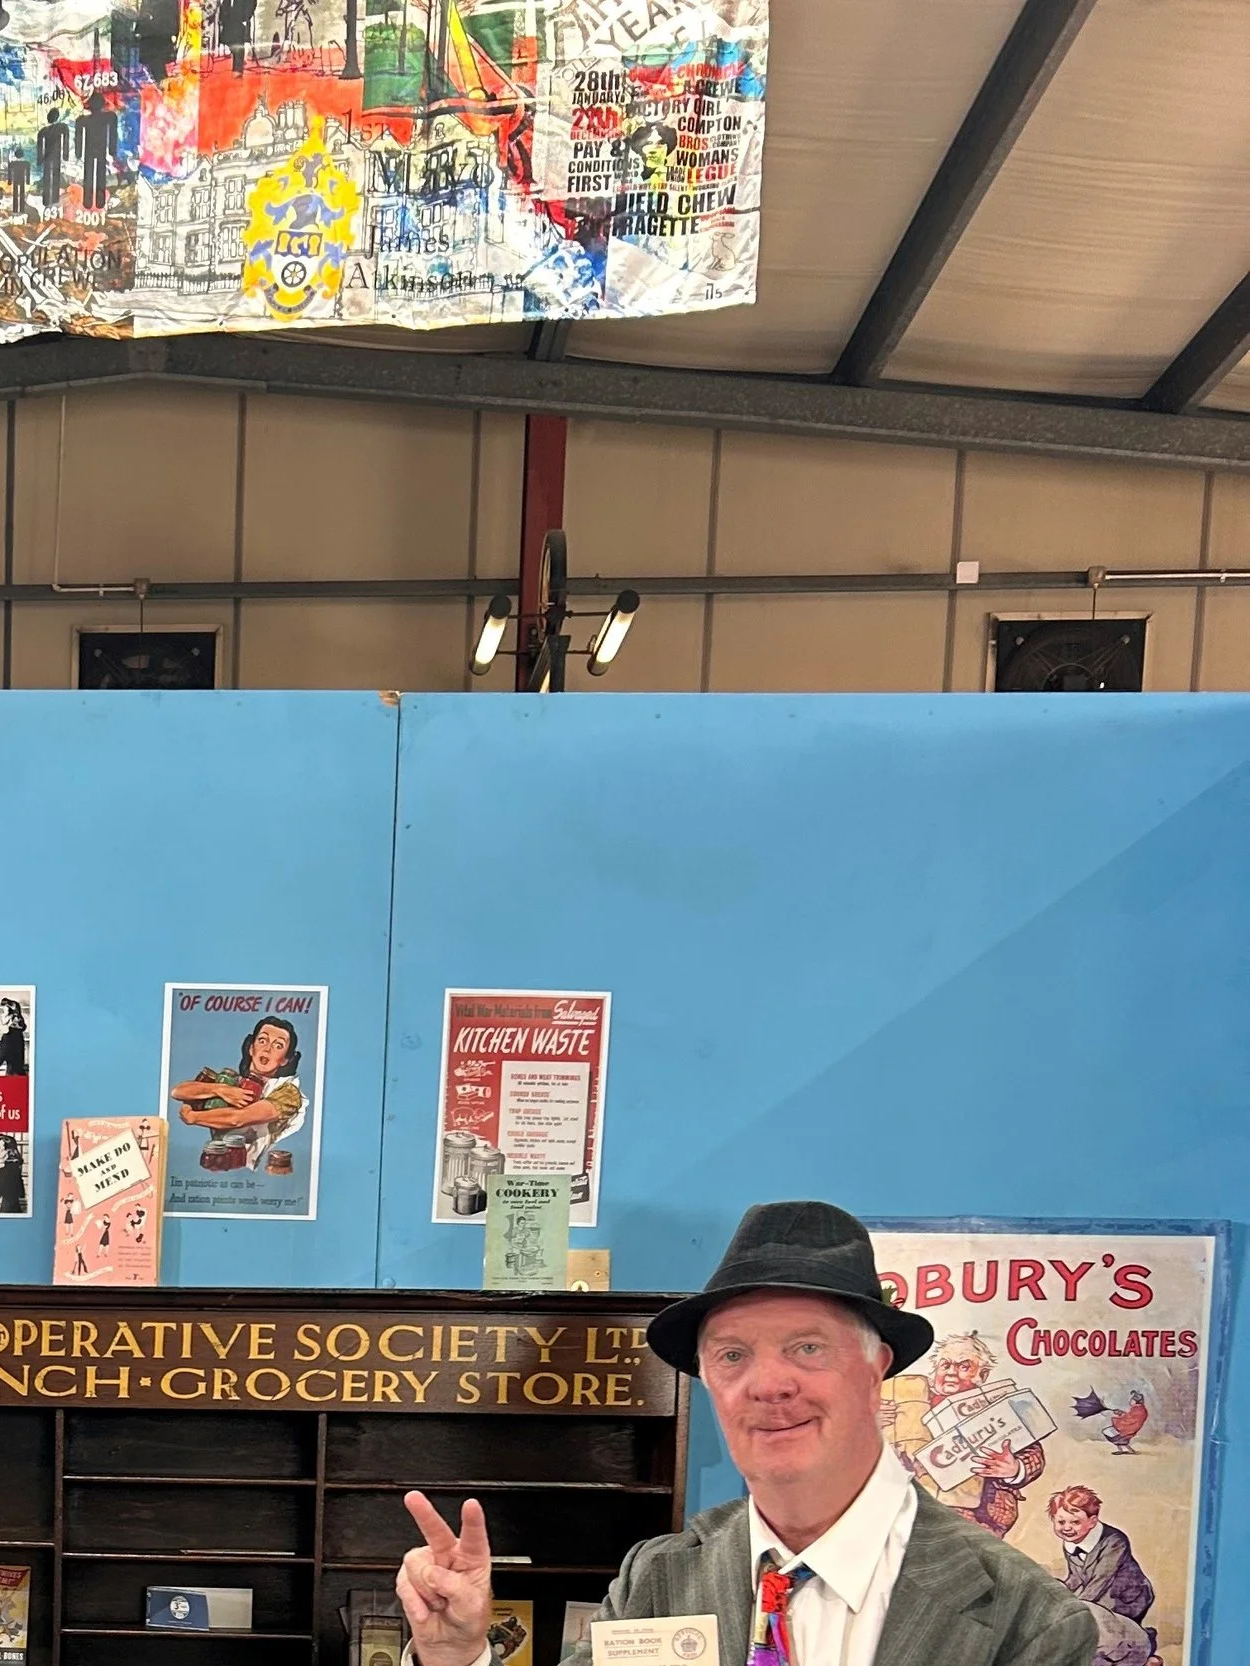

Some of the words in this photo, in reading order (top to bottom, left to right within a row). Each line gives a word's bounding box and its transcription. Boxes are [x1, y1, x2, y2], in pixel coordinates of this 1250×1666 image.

[574, 70, 620, 91] 28th
[693, 97, 722, 116] GIRL
[677, 116, 741, 134] COMPTON
[678, 135, 709, 150] BROS
[676, 148, 739, 168] WOMANS
[567, 174, 614, 193] FIRST
[687, 163, 737, 184] LEGUE
[678, 183, 737, 215] CHEW
[75, 210, 106, 226] 2001
[346, 262, 473, 292] Atkinson
[204, 995, 262, 1013] COURSE
[265, 997, 271, 1012] I
[275, 997, 312, 1014] CAN!
[453, 1027, 530, 1053] KITCHEN
[531, 1029, 595, 1056] WASTE
[8, 1108, 20, 1120] us
[77, 1150, 112, 1177] MAKE
[114, 1142, 132, 1160] DO
[94, 1167, 130, 1193] MEND
[495, 1188, 559, 1198] COOKERY
[293, 1322, 566, 1364] SOCIETY
[1006, 1317, 1198, 1366] CHOCOLATES
[929, 1417, 1006, 1468] Cadbury's
[608, 1648, 659, 1656] SUPPLEMENT
